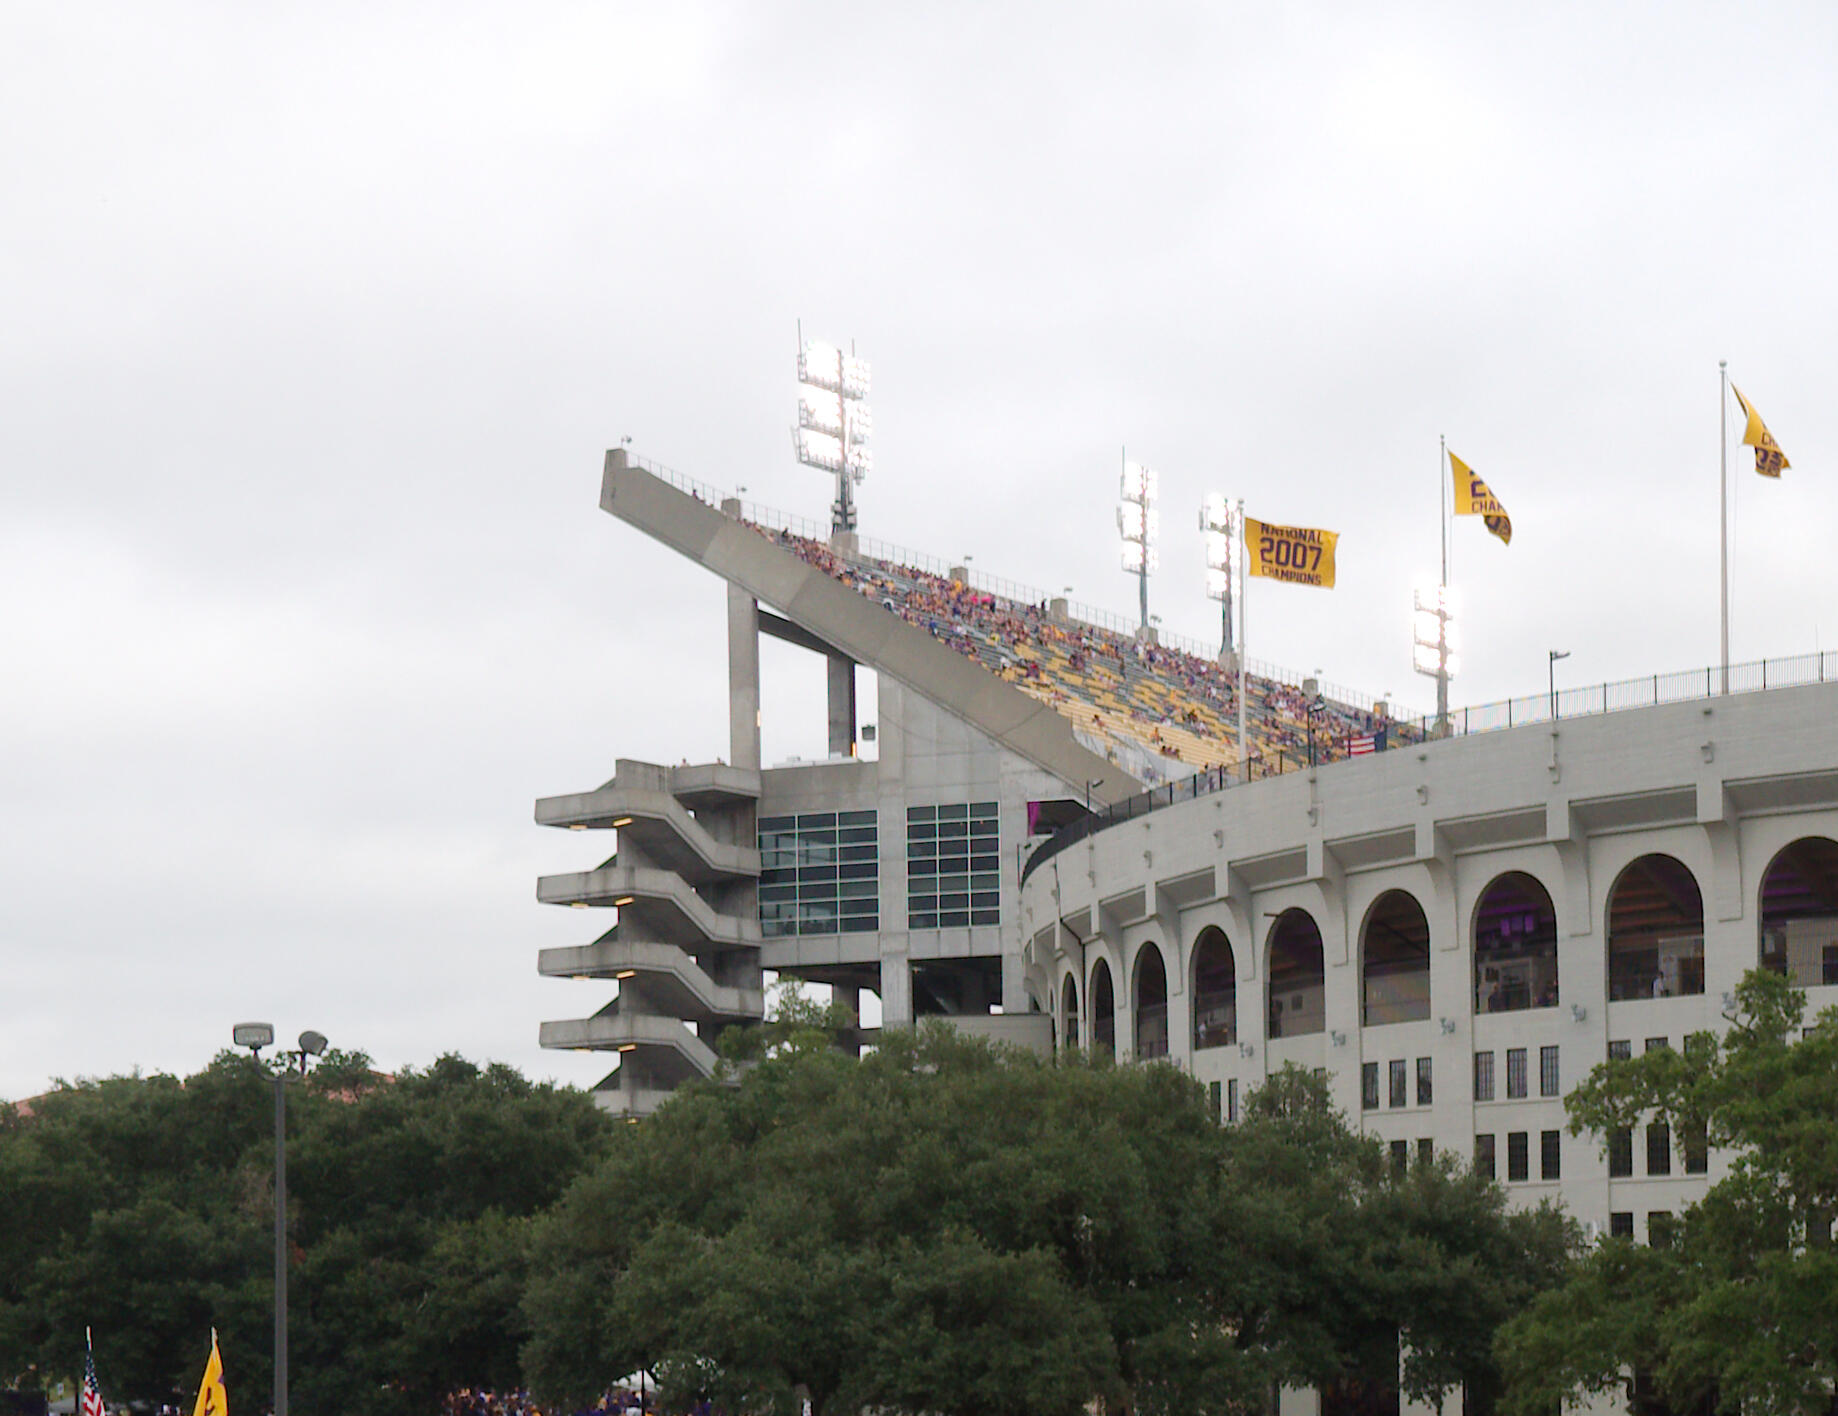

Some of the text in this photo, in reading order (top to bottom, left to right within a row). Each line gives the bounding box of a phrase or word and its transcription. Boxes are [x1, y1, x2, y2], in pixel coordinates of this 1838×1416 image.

[1261, 523, 1323, 545] NATIONAL
[1260, 537, 1322, 571] 2007
[1261, 565, 1321, 586] CHAMPIONS
